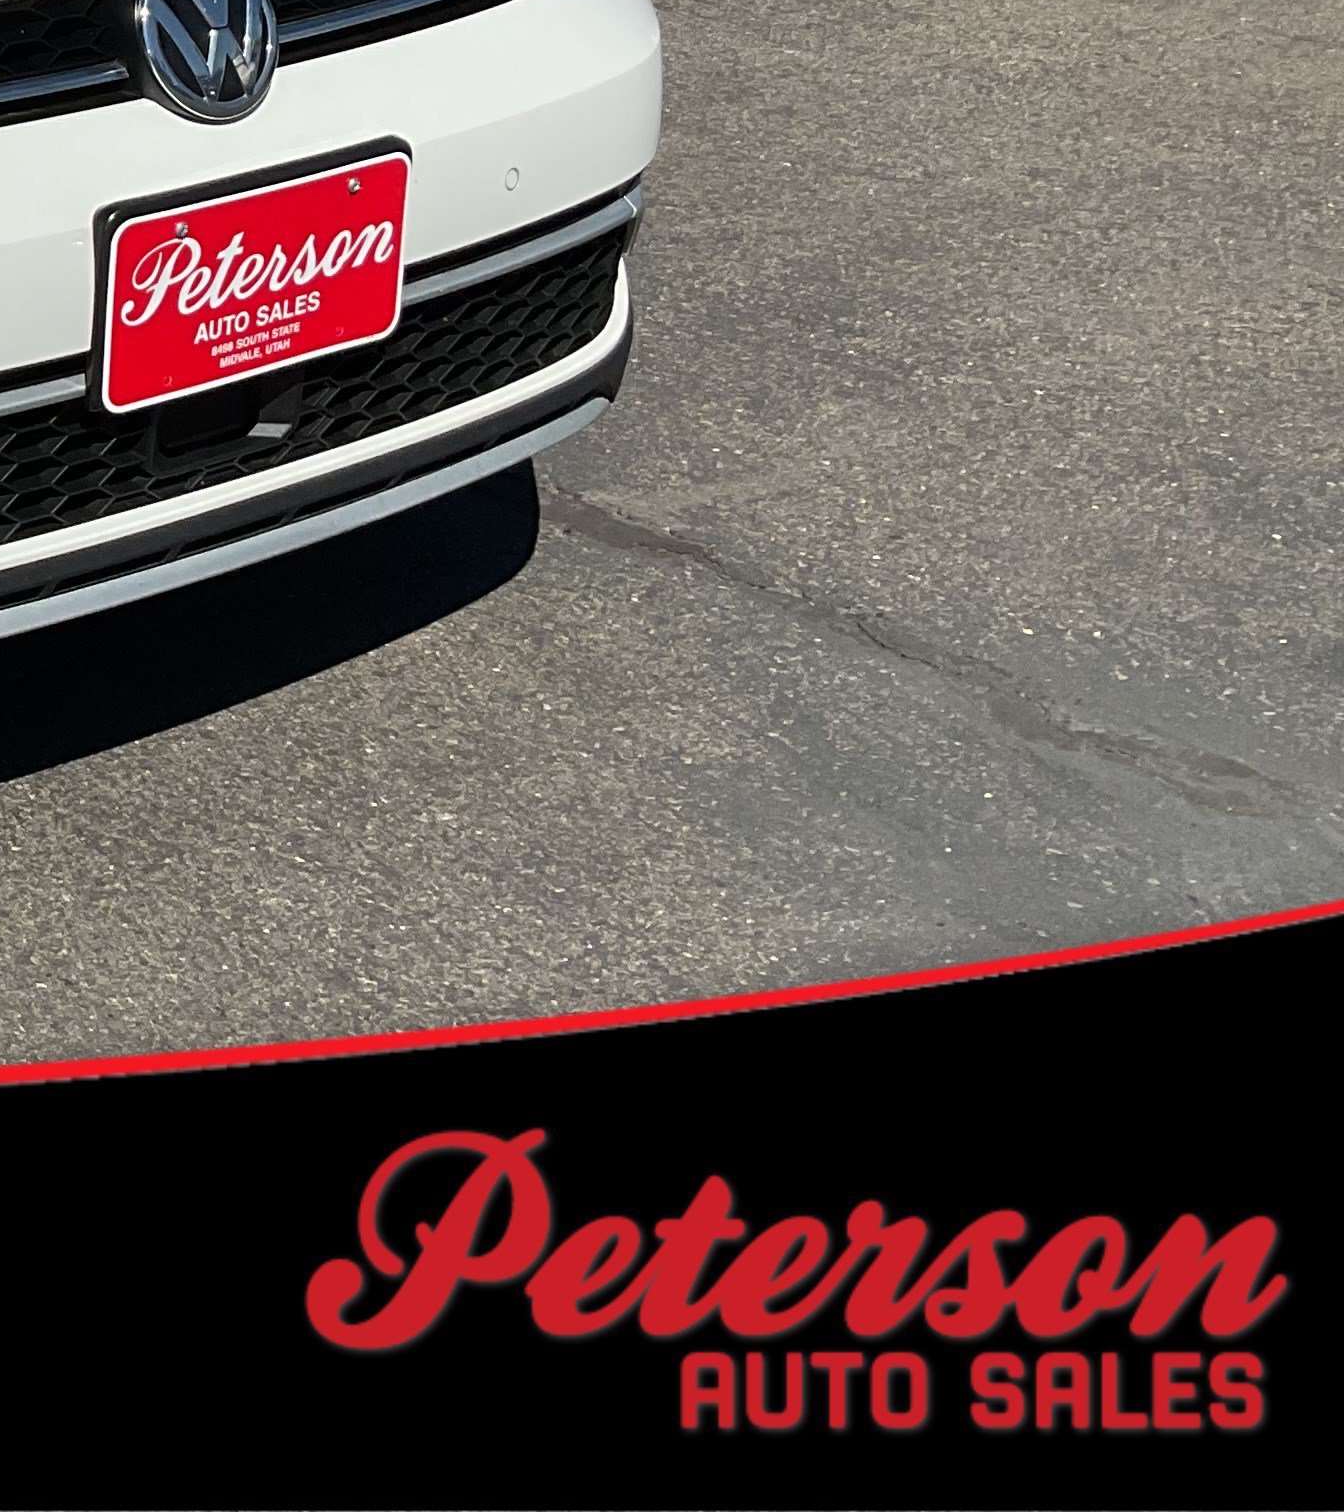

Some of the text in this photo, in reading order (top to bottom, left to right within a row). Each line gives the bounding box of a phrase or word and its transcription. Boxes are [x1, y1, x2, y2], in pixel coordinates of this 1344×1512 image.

[121, 221, 394, 326] Peterson
[194, 291, 321, 345] AUTO SALES
[236, 331, 270, 349] SOUTH
[272, 322, 300, 340] STATE
[265, 338, 291, 355] UTAH
